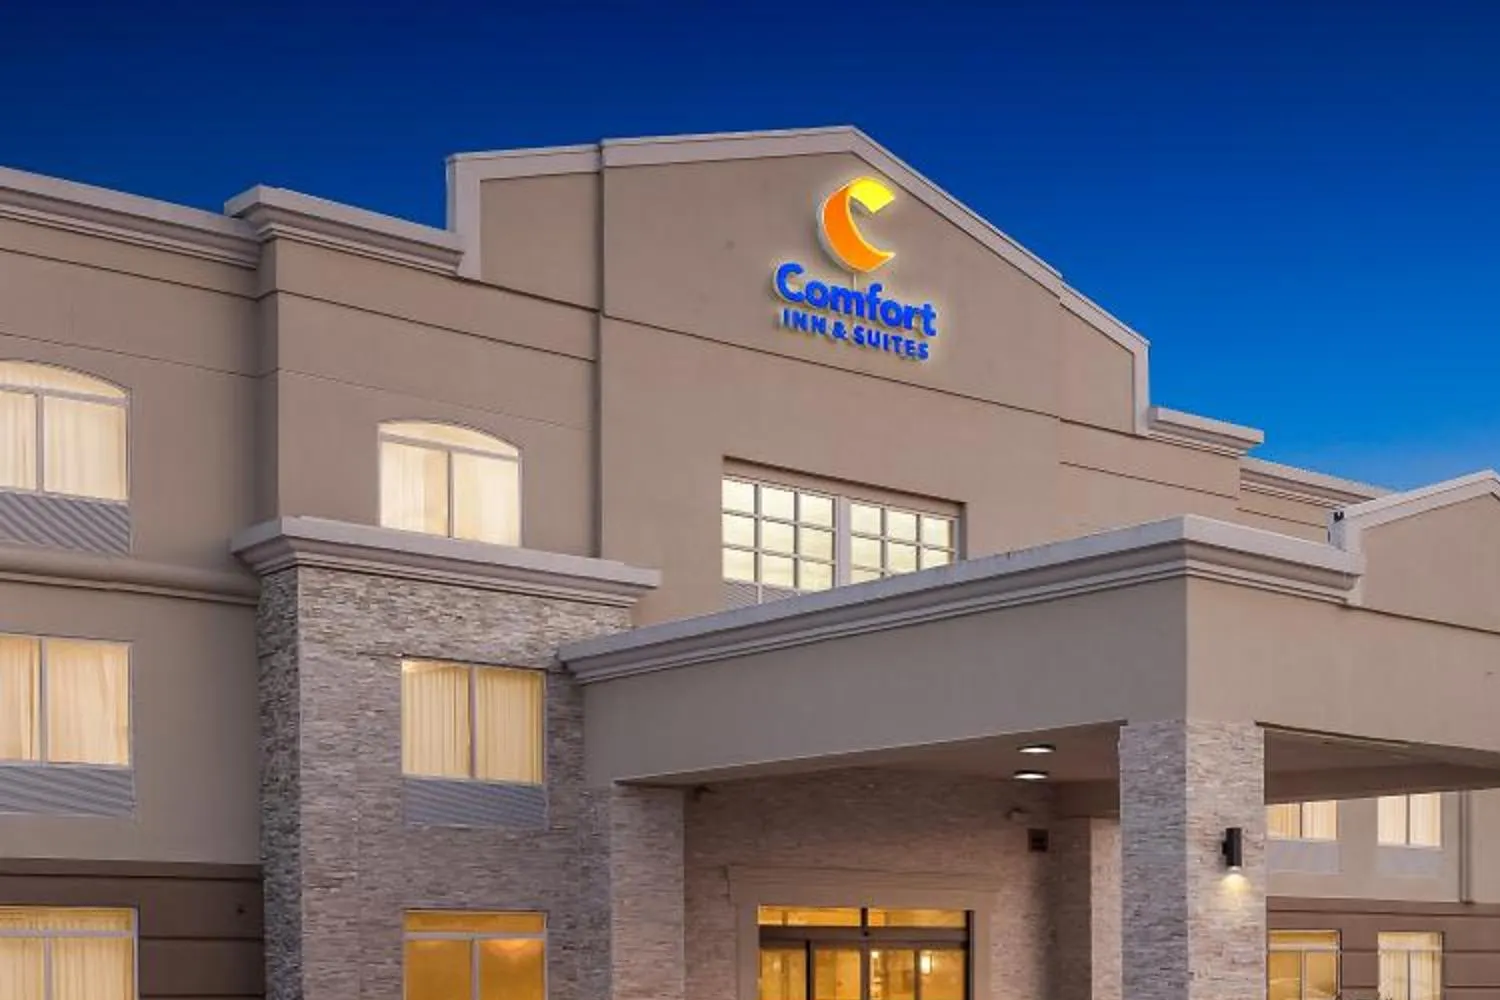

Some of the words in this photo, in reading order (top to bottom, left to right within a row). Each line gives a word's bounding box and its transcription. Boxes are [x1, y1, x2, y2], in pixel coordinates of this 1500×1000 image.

[775, 262, 937, 337] Comfort
[782, 308, 828, 335] INN
[831, 319, 848, 340] &
[853, 325, 929, 360] SUITES
